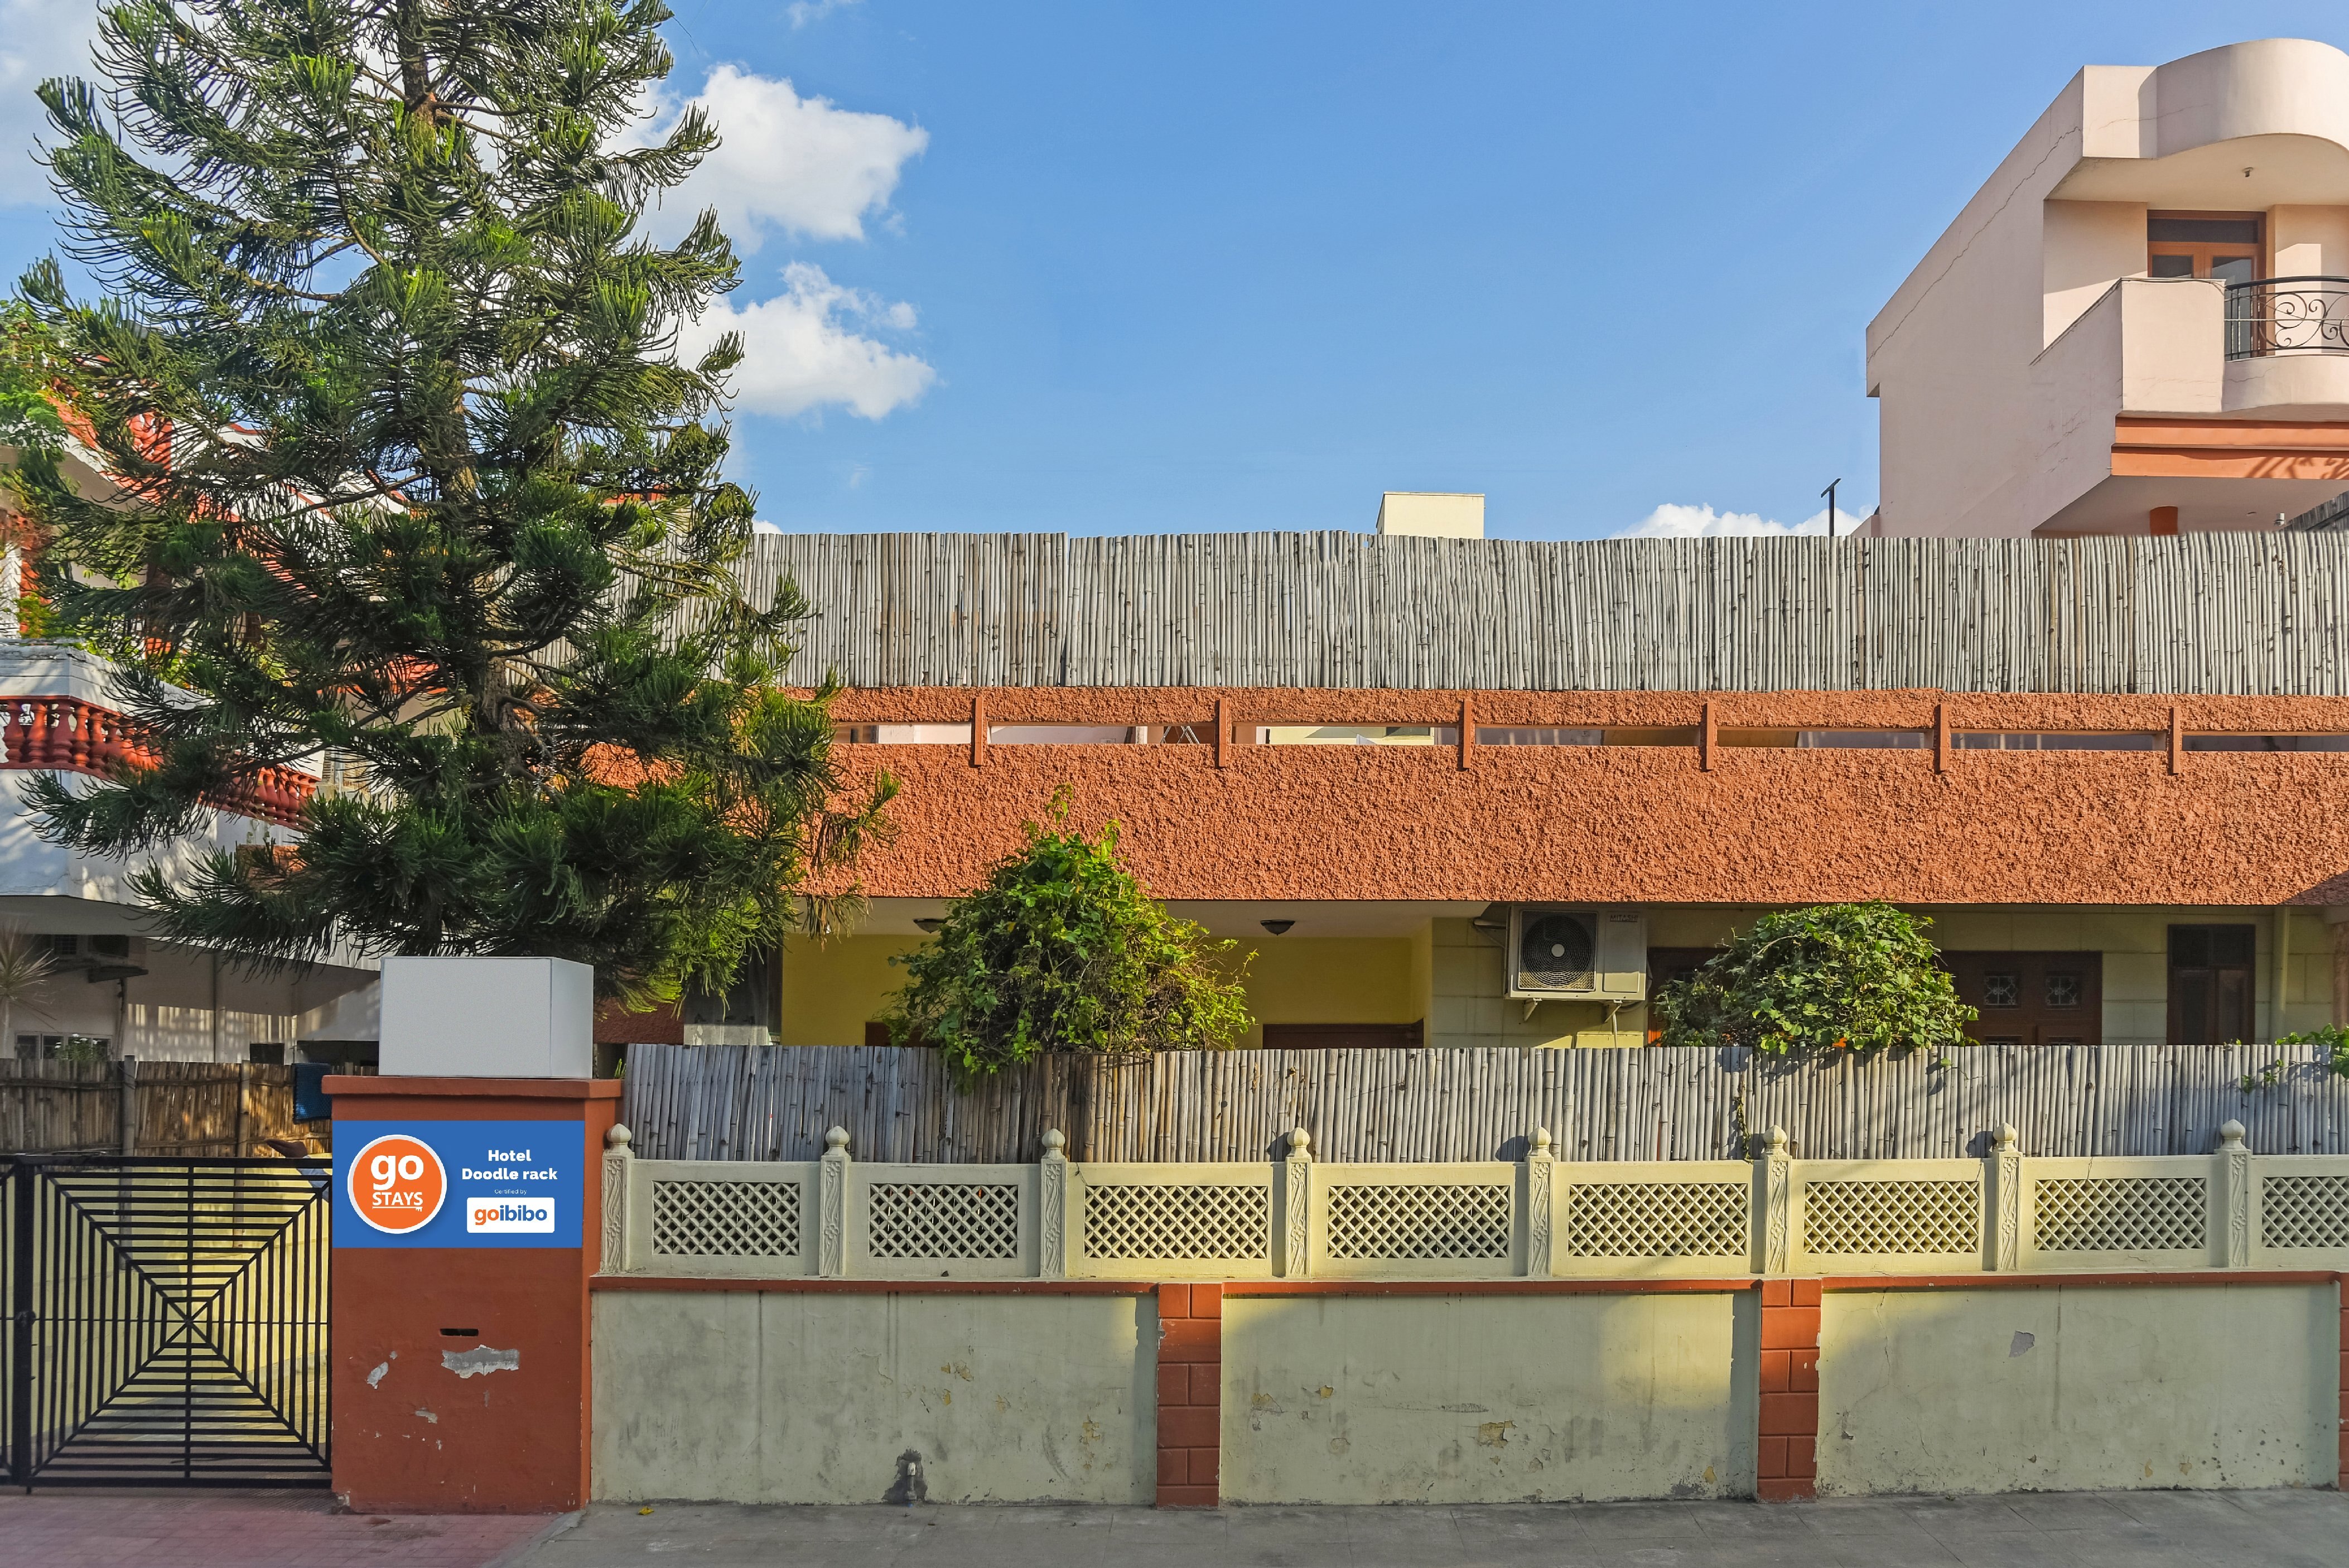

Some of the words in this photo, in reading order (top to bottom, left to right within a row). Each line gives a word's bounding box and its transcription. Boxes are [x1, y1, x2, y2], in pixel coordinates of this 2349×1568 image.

[488, 1149, 532, 1161] Hotel
[370, 1155, 425, 1190] go
[462, 1167, 519, 1180] Doodle
[523, 1167, 558, 1180] rack
[372, 1191, 423, 1206] STAYS
[474, 1205, 547, 1226] goibibo
